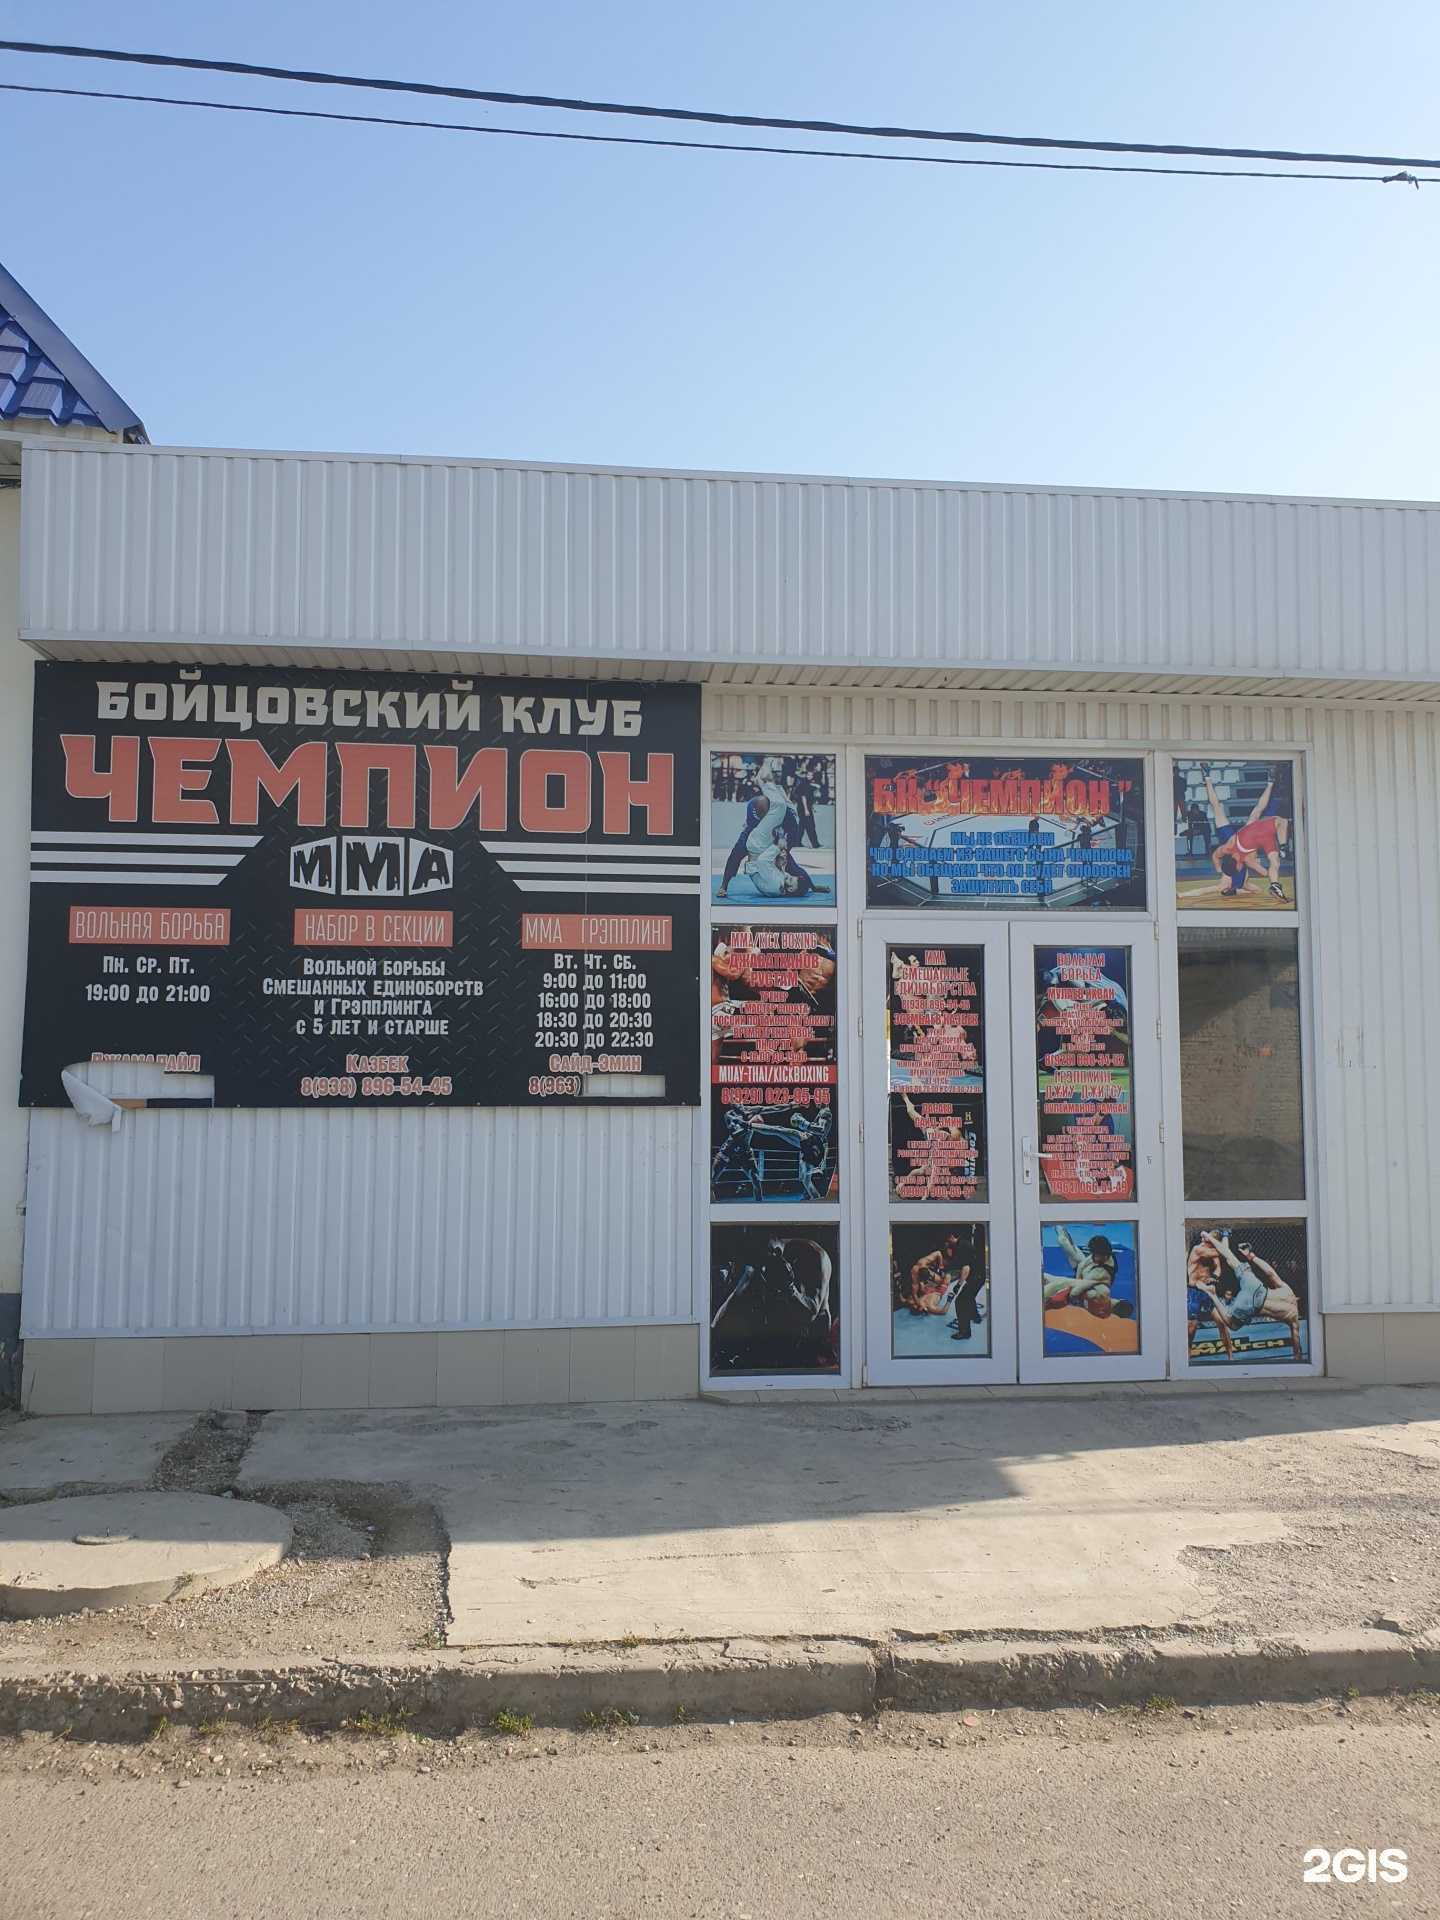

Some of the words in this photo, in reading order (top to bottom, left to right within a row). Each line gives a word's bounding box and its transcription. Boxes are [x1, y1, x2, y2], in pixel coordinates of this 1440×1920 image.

[96, 668, 480, 732] БОЙЦОВСКИЙ
[500, 695, 643, 737] КЛУБ
[59, 733, 674, 836] ЧЕМПИОН
[75, 911, 153, 940] ВОЛЬНАЯ
[159, 912, 226, 941] БОРЬБА
[304, 913, 359, 942] НАБОР
[365, 915, 376, 942] В
[382, 914, 445, 944] СЕКЦИИ
[525, 918, 563, 943] ММА
[581, 918, 670, 945] ГРЭППЛИНГ
[543, 973, 577, 989] 9:00
[609, 973, 647, 989] 11:00
[1060, 967, 1102, 981] БОРЬБА
[86, 984, 130, 1002] 19:00
[165, 985, 210, 1002] 21:00
[538, 993, 579, 1009] 16:00
[611, 993, 651, 1009] 18:00
[313, 1018, 323, 1035] 5
[536, 1012, 577, 1028] 18:30
[610, 1012, 652, 1028] 20:30
[535, 1031, 579, 1048] 20:30
[611, 1032, 654, 1048] 22:30
[719, 1064, 829, 1083] MUAY-THAI/KICKBOXING
[301, 1077, 357, 1098] 8(938)
[362, 1077, 453, 1096] 896-54-45
[528, 1076, 581, 1097] 8(963)
